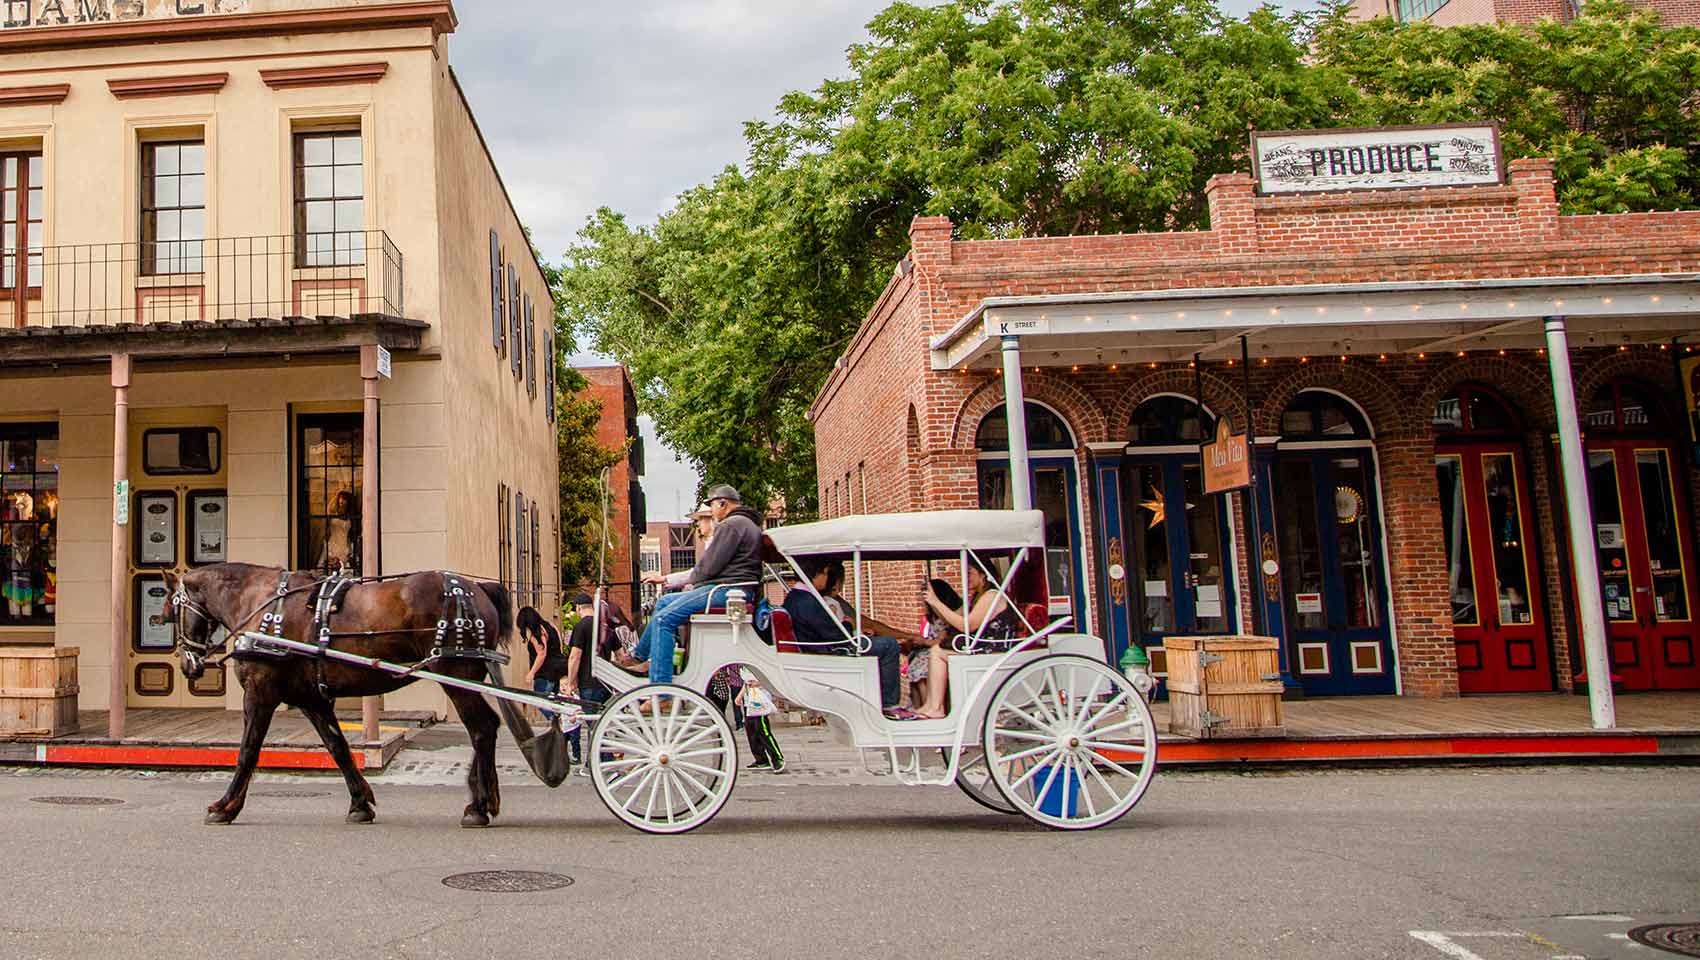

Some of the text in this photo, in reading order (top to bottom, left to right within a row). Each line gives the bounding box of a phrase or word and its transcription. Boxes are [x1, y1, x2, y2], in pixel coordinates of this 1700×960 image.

[1263, 145, 1296, 161] BEANS
[1310, 143, 1442, 177] PRODUCE
[1000, 321, 1036, 334] K STREET
